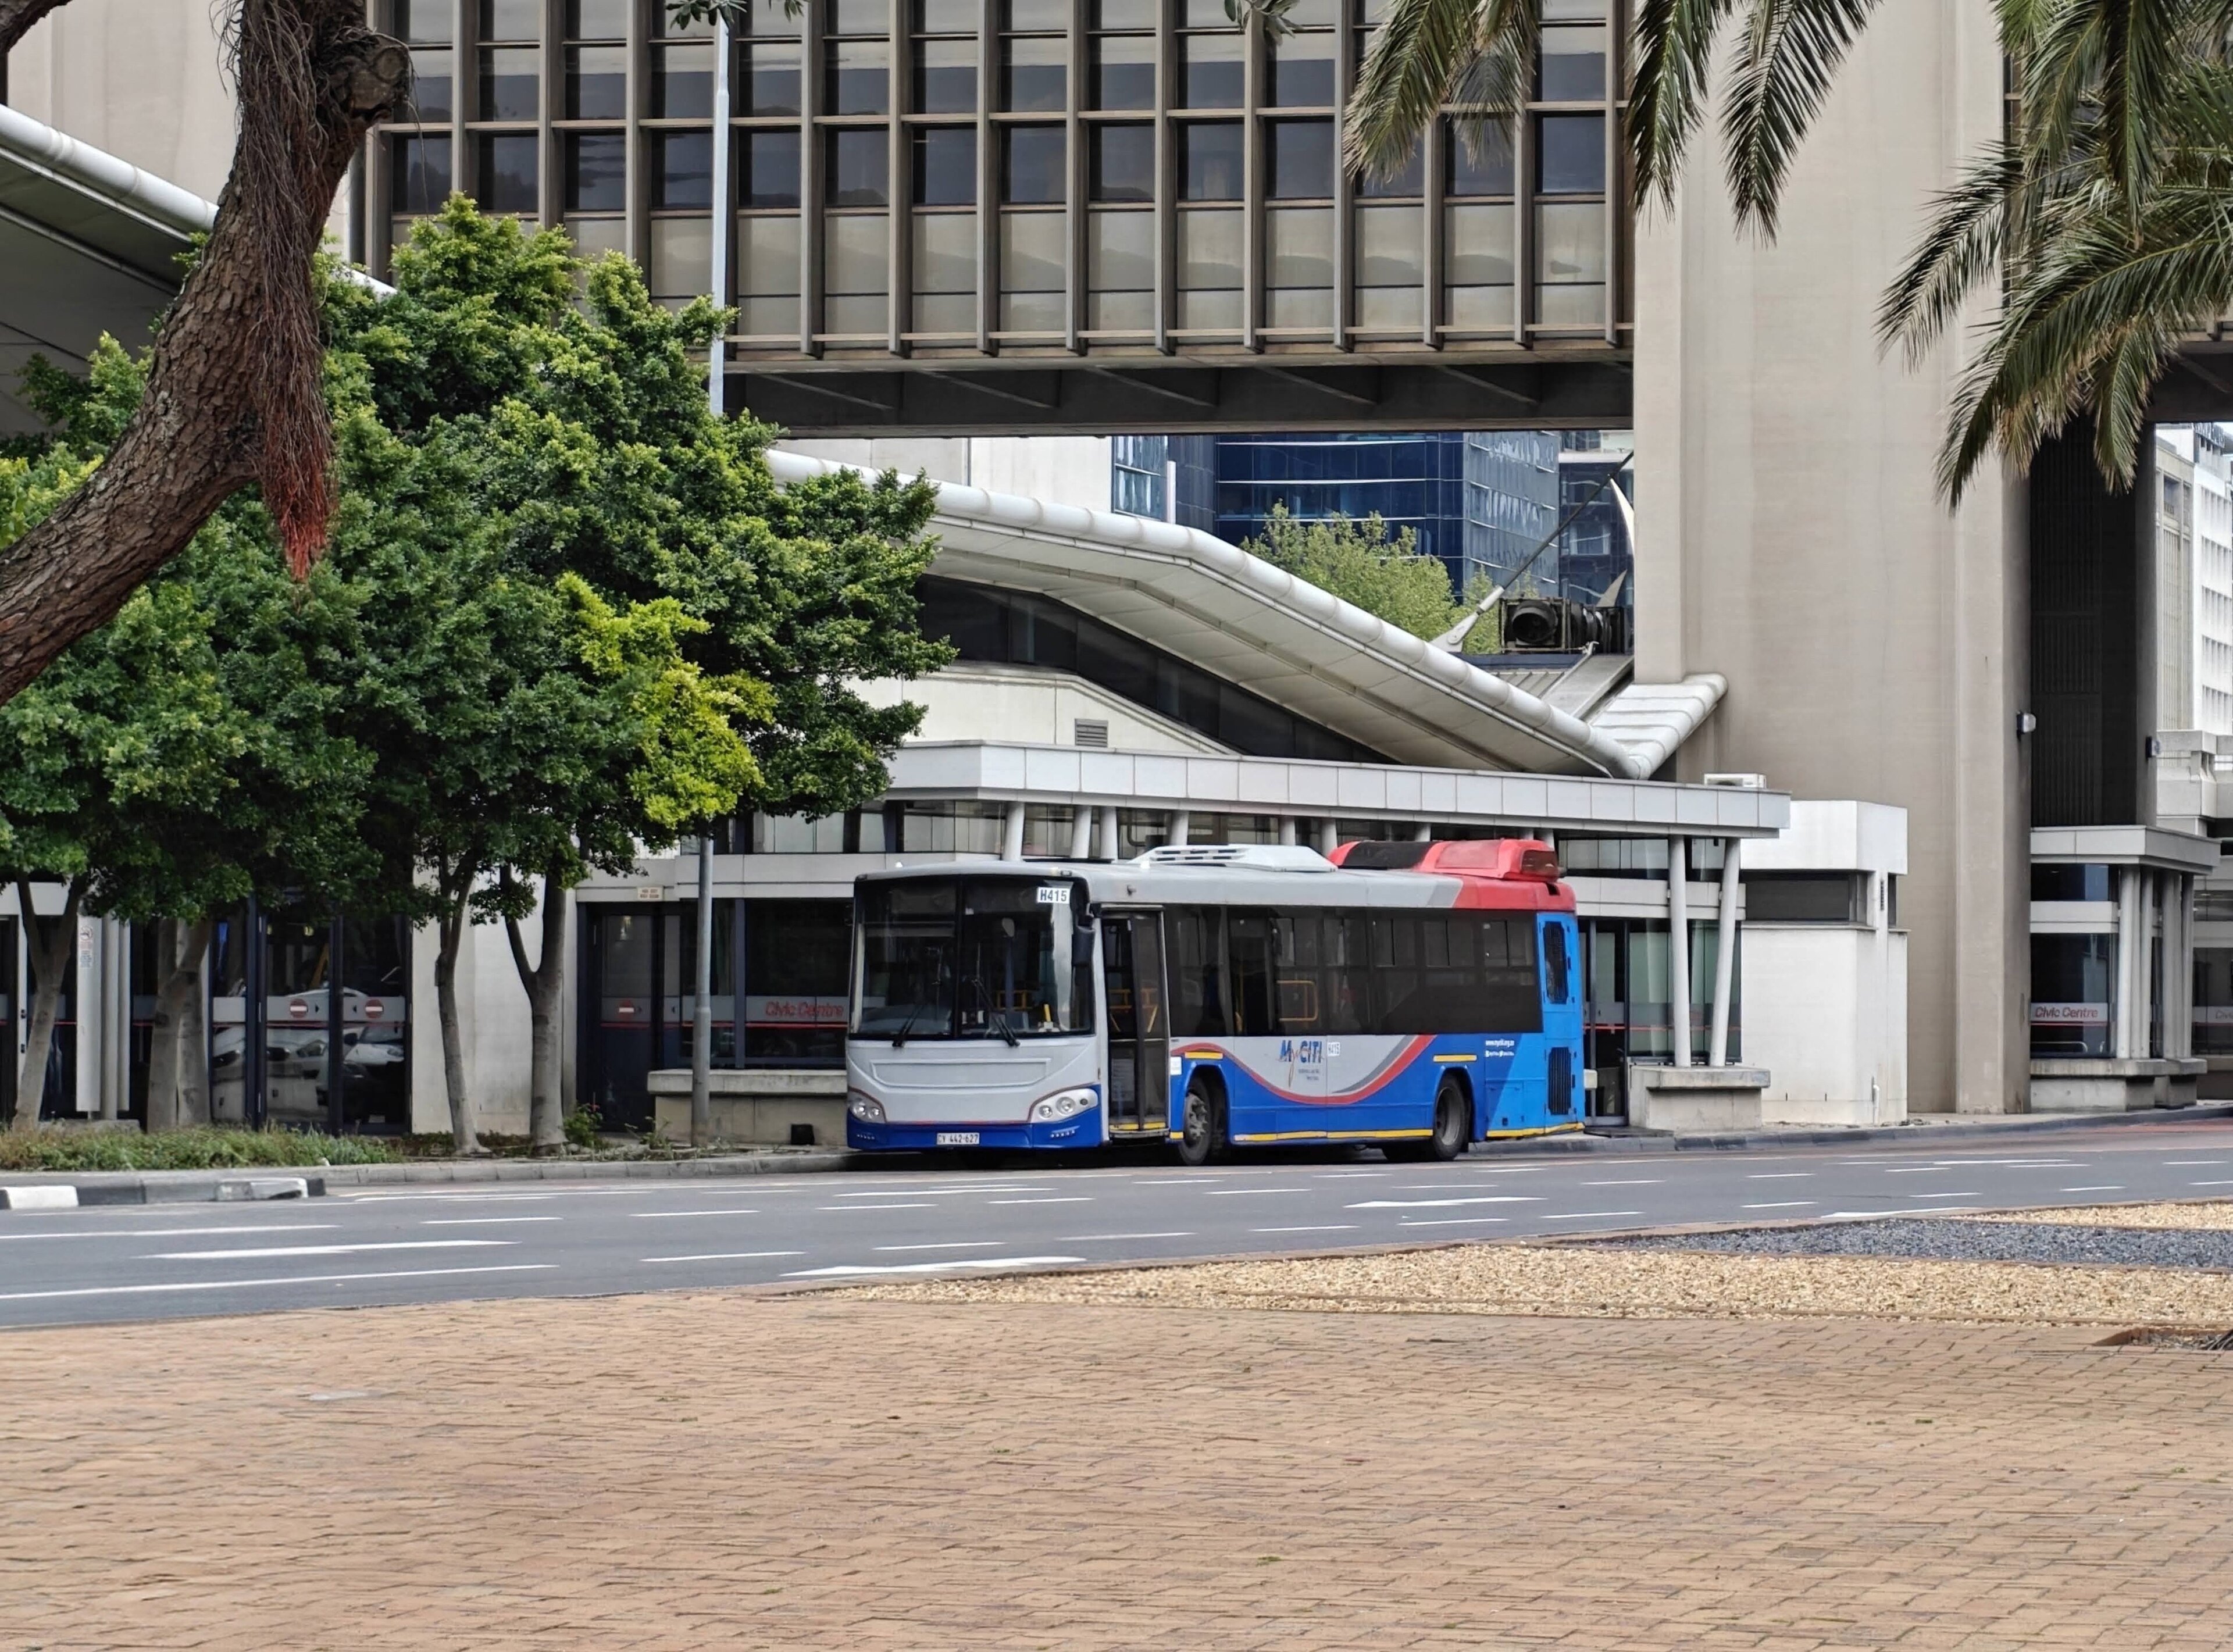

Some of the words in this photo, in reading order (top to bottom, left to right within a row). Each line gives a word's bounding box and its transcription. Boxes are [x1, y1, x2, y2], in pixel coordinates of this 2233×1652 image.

[1040, 889, 1066, 902] H415
[765, 1001, 796, 1016] Civic
[2035, 1005, 2060, 1018] Civic
[2062, 1007, 2098, 1018] Centre
